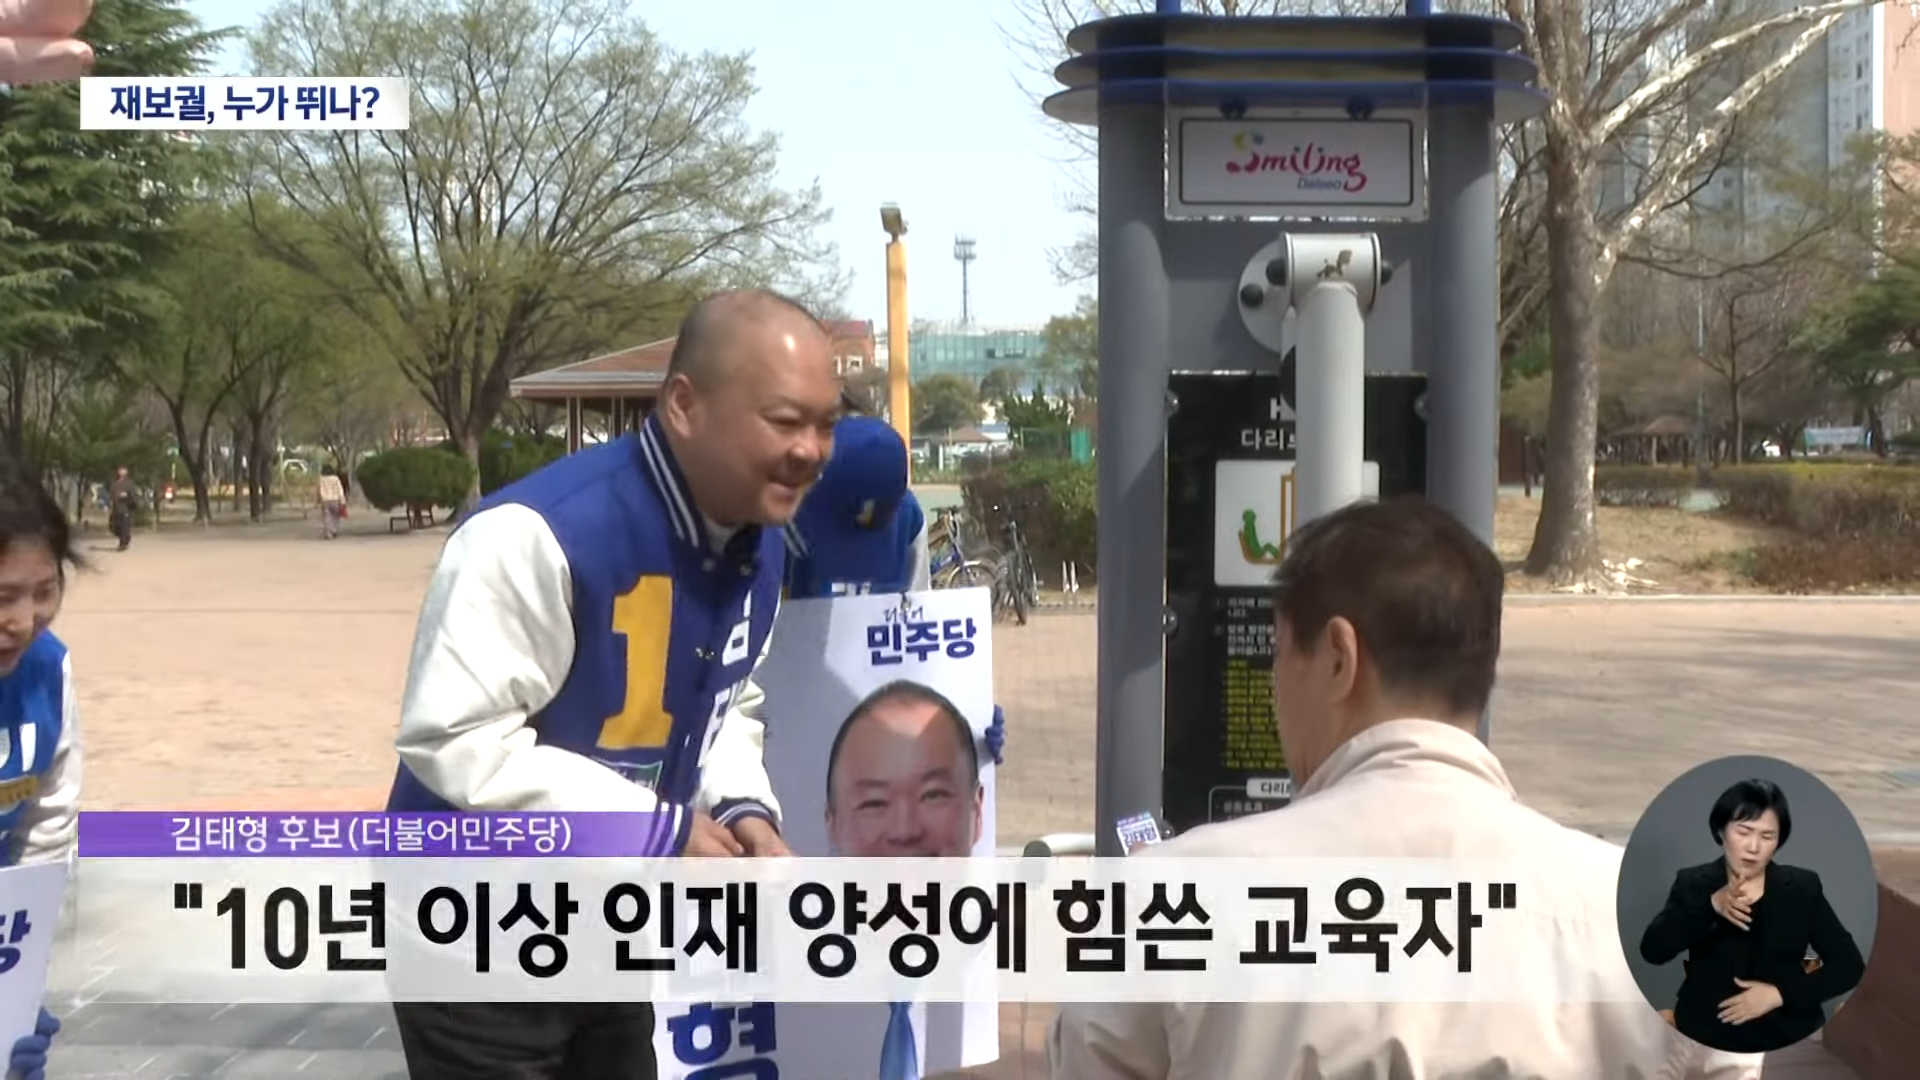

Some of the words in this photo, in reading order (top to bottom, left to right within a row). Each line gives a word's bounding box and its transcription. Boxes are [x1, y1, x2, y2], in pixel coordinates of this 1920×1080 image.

[1226, 133, 1367, 192] Smiling
[596, 574, 674, 750] 1
[867, 617, 977, 666] 민주당
